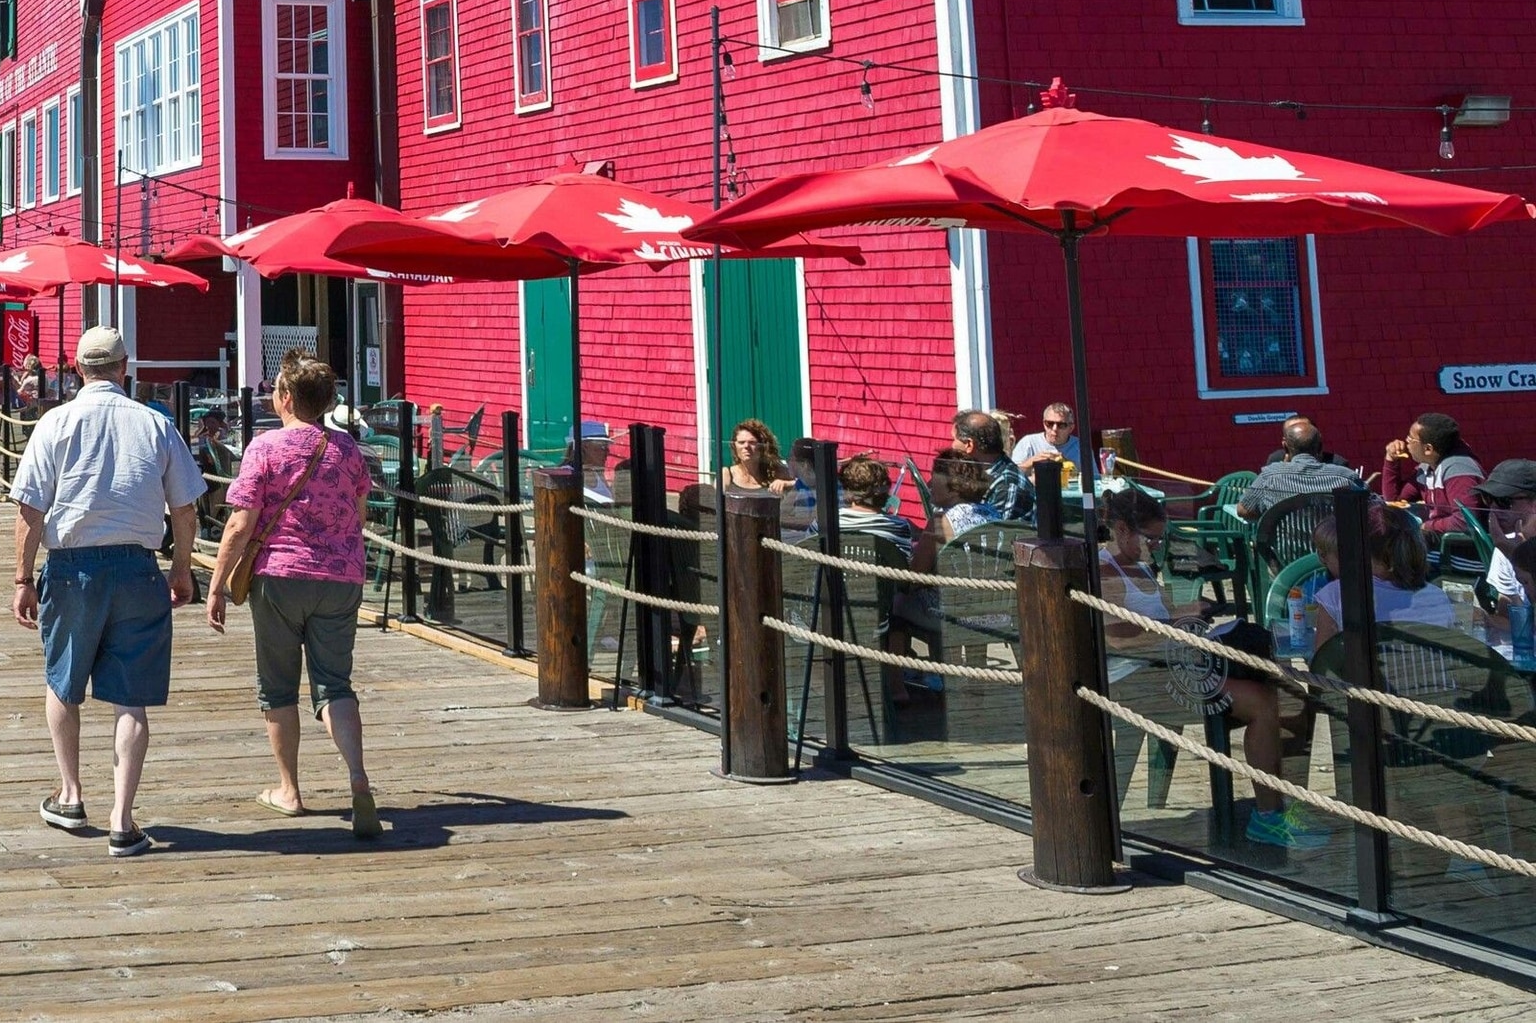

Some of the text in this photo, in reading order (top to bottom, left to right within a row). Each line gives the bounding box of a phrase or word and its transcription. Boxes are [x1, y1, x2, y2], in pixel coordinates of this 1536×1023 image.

[27, 41, 58, 88] ATLANTIC
[660, 245, 732, 261] CANADI
[1453, 369, 1536, 390] Snow Cra
[1165, 681, 1234, 716] RESTAURANT
